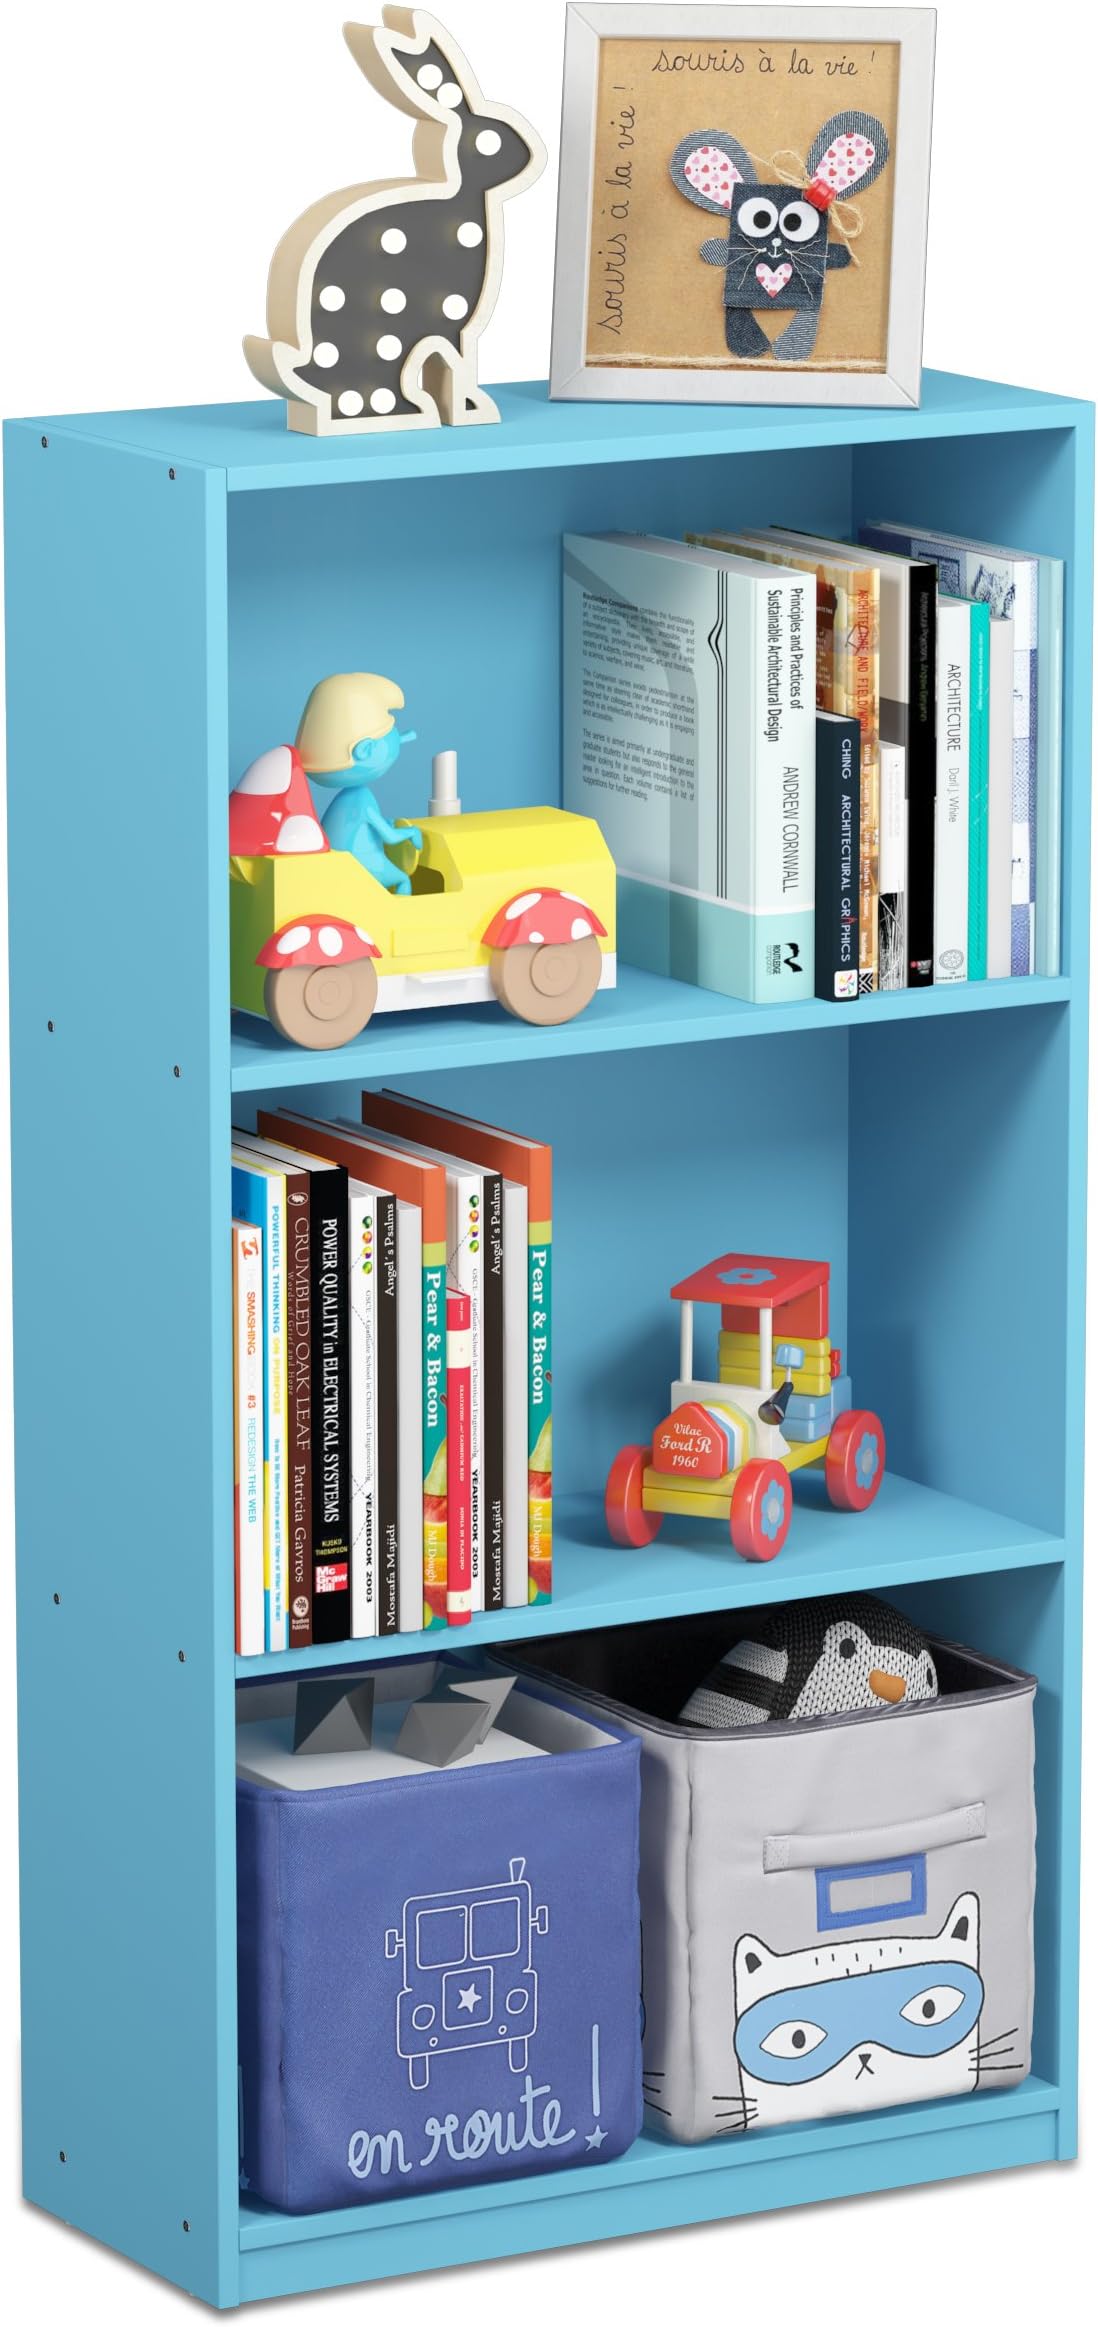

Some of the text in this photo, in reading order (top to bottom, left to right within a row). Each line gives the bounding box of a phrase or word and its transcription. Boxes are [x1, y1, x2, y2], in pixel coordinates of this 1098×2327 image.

[651, 49, 745, 73] souris
[758, 48, 775, 73] à
[788, 48, 813, 75] la
[825, 56, 858, 76] vie
[610, 105, 635, 150] vie
[605, 163, 632, 190] la
[601, 201, 629, 219] à
[598, 232, 628, 335] souris
[764, 590, 782, 742] Sustainable Architectural Design
[788, 587, 804, 709] Principles and Practices of
[857, 656, 869, 672] AND
[947, 664, 961, 751] ARCHITECTURE
[783, 766, 798, 893] ANDREW CORNWALL
[948, 796, 959, 822] White
[841, 738, 858, 962] CHING ARCHITECTURAL GRAPHICS
[772, 945, 781, 975] ROUTLEDGE
[384, 1203, 395, 1247] Psalms
[490, 1182, 501, 1226] Psalms
[272, 1206, 280, 1270] POWERFUL
[247, 1291, 256, 1355] SMASHING
[272, 1273, 280, 1333] THINKING
[295, 1217, 310, 1450] CRUMBLED OAK LEAF
[532, 1248, 547, 1405] Pear & Bacon
[319, 1218, 339, 1523] POWER QUALITY in ELECTRICAL SYSTEMS
[364, 1355, 372, 1381] School
[427, 1272, 441, 1427] Pear & Bacon
[247, 1394, 256, 1408] #3
[247, 1417, 256, 1472] REDESIGN
[660, 1435, 712, 1453] Ford R
[673, 1422, 702, 1436] Vilac
[672, 1455, 699, 1468] 1960
[248, 1474, 256, 1495] THE
[248, 1498, 256, 1523] WEB
[294, 1464, 306, 1583] Patricia Gavros
[316, 1566, 336, 1576] Mc
[492, 1500, 503, 1601] Mostafa Majidi
[316, 1573, 347, 1584] Graw
[316, 1582, 335, 1593] Hill
[386, 1524, 397, 1626] Mostafa Majidi
[348, 2130, 412, 2179] en
[420, 2075, 576, 2166] route
